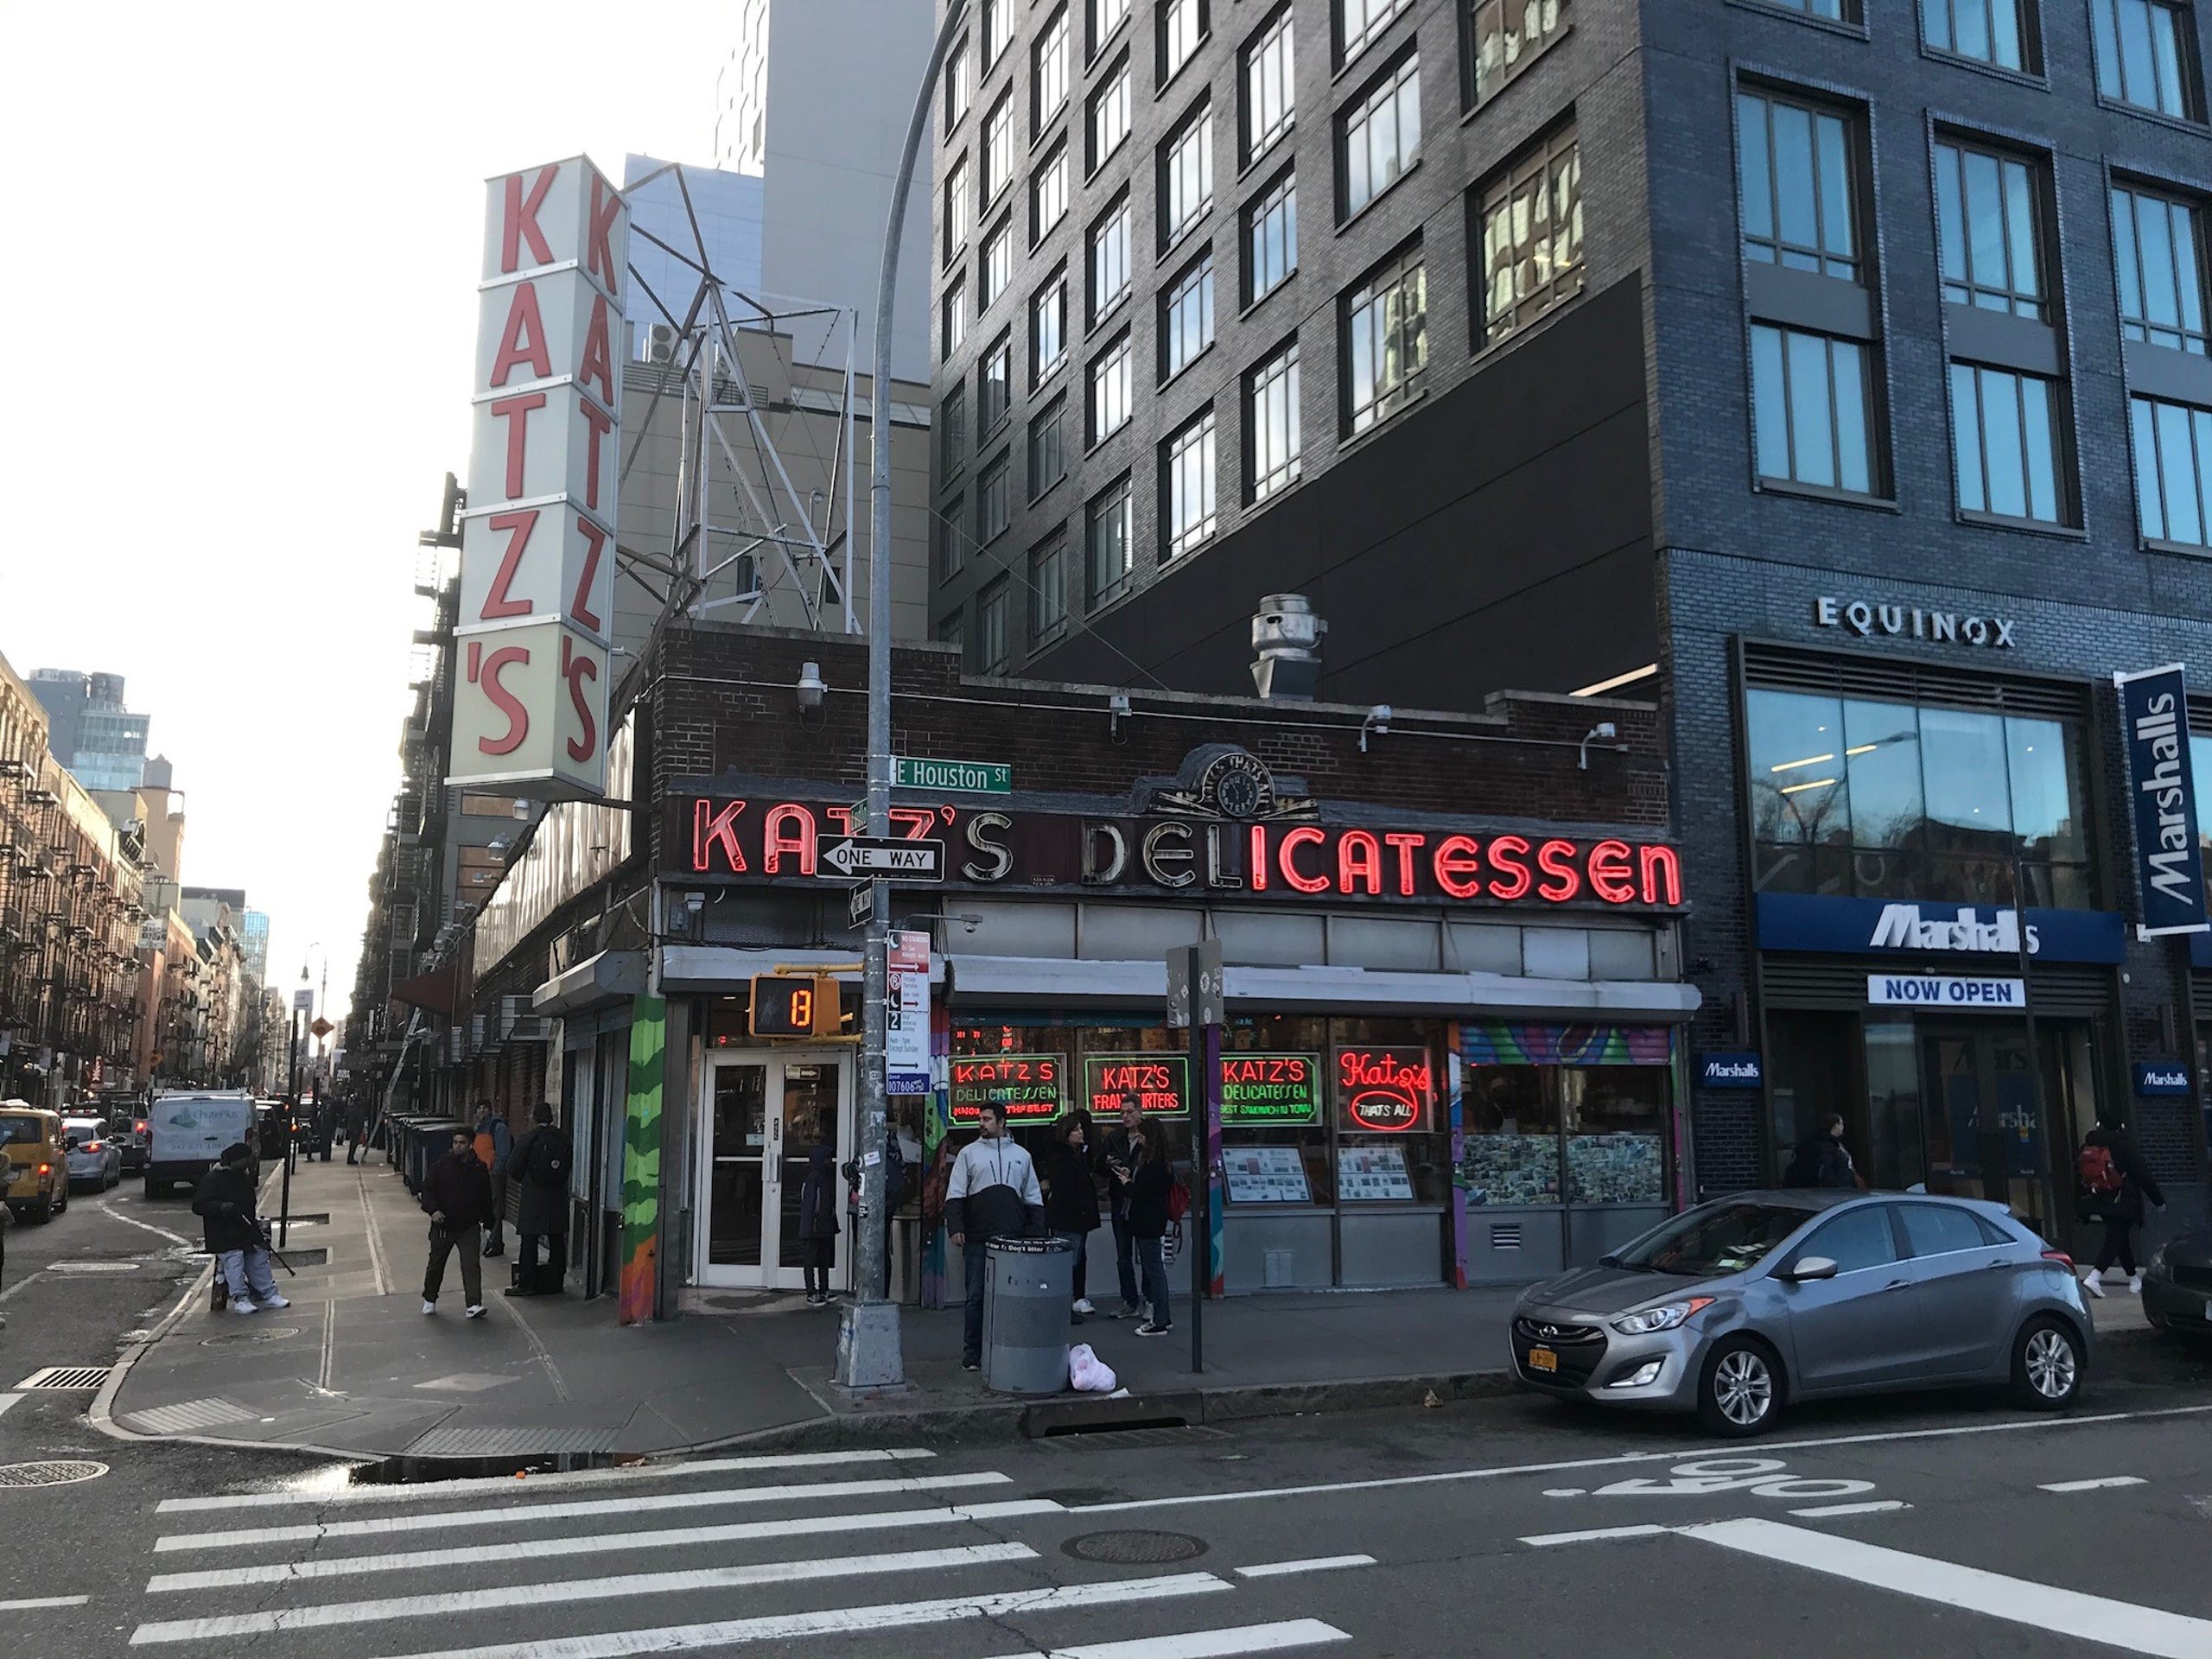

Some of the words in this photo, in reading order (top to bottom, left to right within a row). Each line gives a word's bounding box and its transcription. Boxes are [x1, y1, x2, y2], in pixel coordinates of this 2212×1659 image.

[467, 164, 560, 756] KATZ'S
[562, 172, 622, 763] KATZ'S
[1817, 596, 2016, 647] EQUINOX
[897, 760, 906, 783] E
[913, 761, 988, 789] Houston
[995, 767, 1007, 782] St
[2136, 692, 2193, 905] Marshalls
[836, 849, 872, 865] ONE
[889, 851, 927, 868] WAY
[1080, 818, 1681, 907] DELICATESSEN
[1885, 979, 1941, 1001] NOW
[1948, 982, 2012, 1002] OPEN
[890, 1013, 899, 1029] 2
[1103, 1064, 1170, 1090] KATZ'S
[1223, 1058, 1305, 1083] KATZ'S
[1340, 1052, 1431, 1090] Katz's
[1705, 1062, 1759, 1077] Marshalls
[2144, 1071, 2188, 1086] Marshalls
[956, 1084, 1057, 1102] DELICATESSEN
[1223, 1084, 1307, 1100] DELICATESSEN
[1394, 1103, 1412, 1117] ALL
